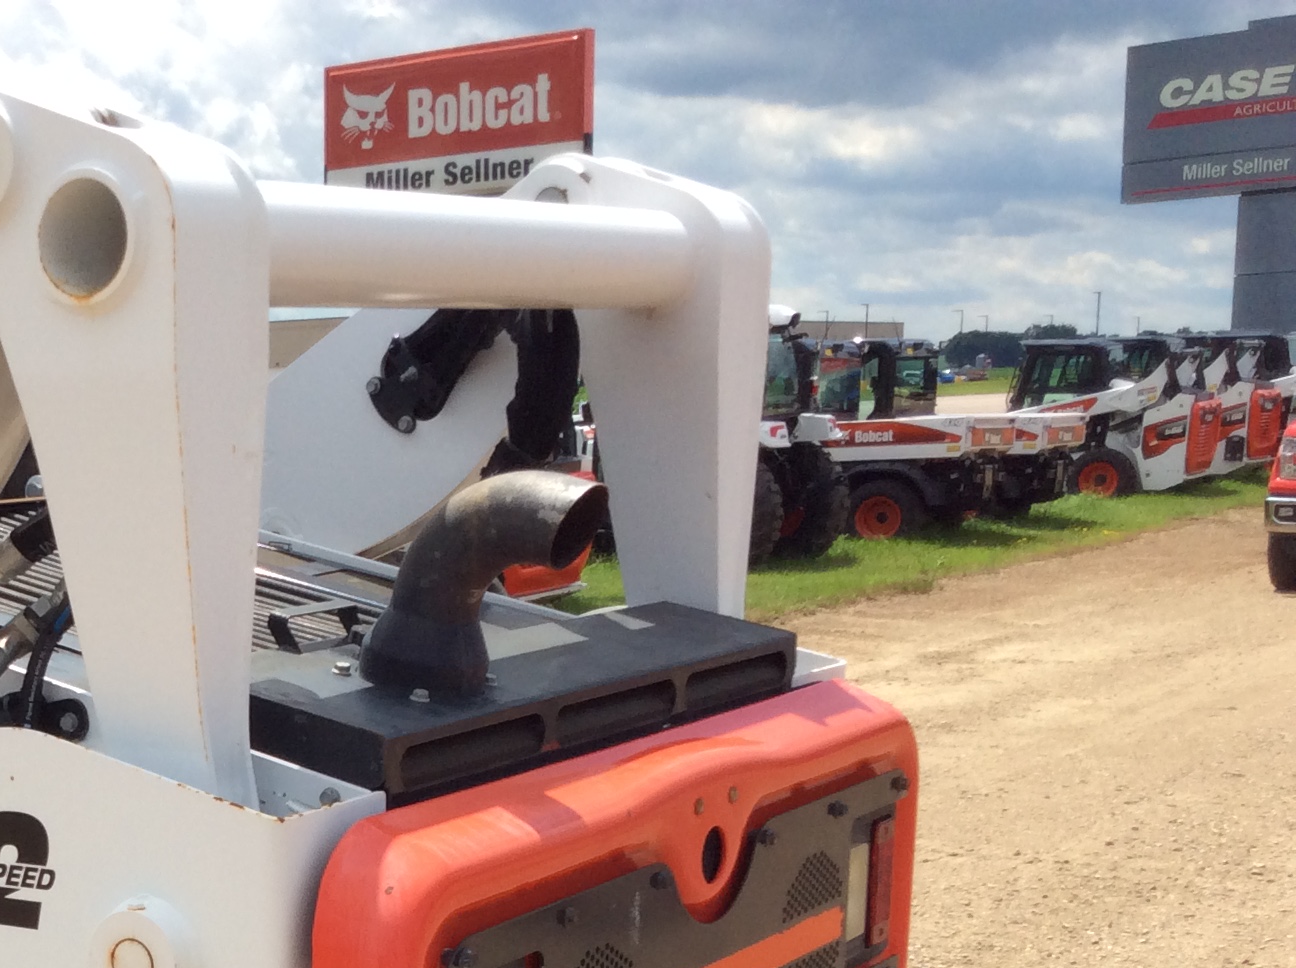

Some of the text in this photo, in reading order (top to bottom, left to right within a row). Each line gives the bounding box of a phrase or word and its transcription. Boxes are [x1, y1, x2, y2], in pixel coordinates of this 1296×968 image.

[1159, 64, 1295, 108] CASE
[407, 73, 551, 138] Bobcat
[365, 157, 534, 191] Miller Sellner
[1183, 157, 1291, 181] Miller Sellner
[855, 429, 894, 443] Bobcat
